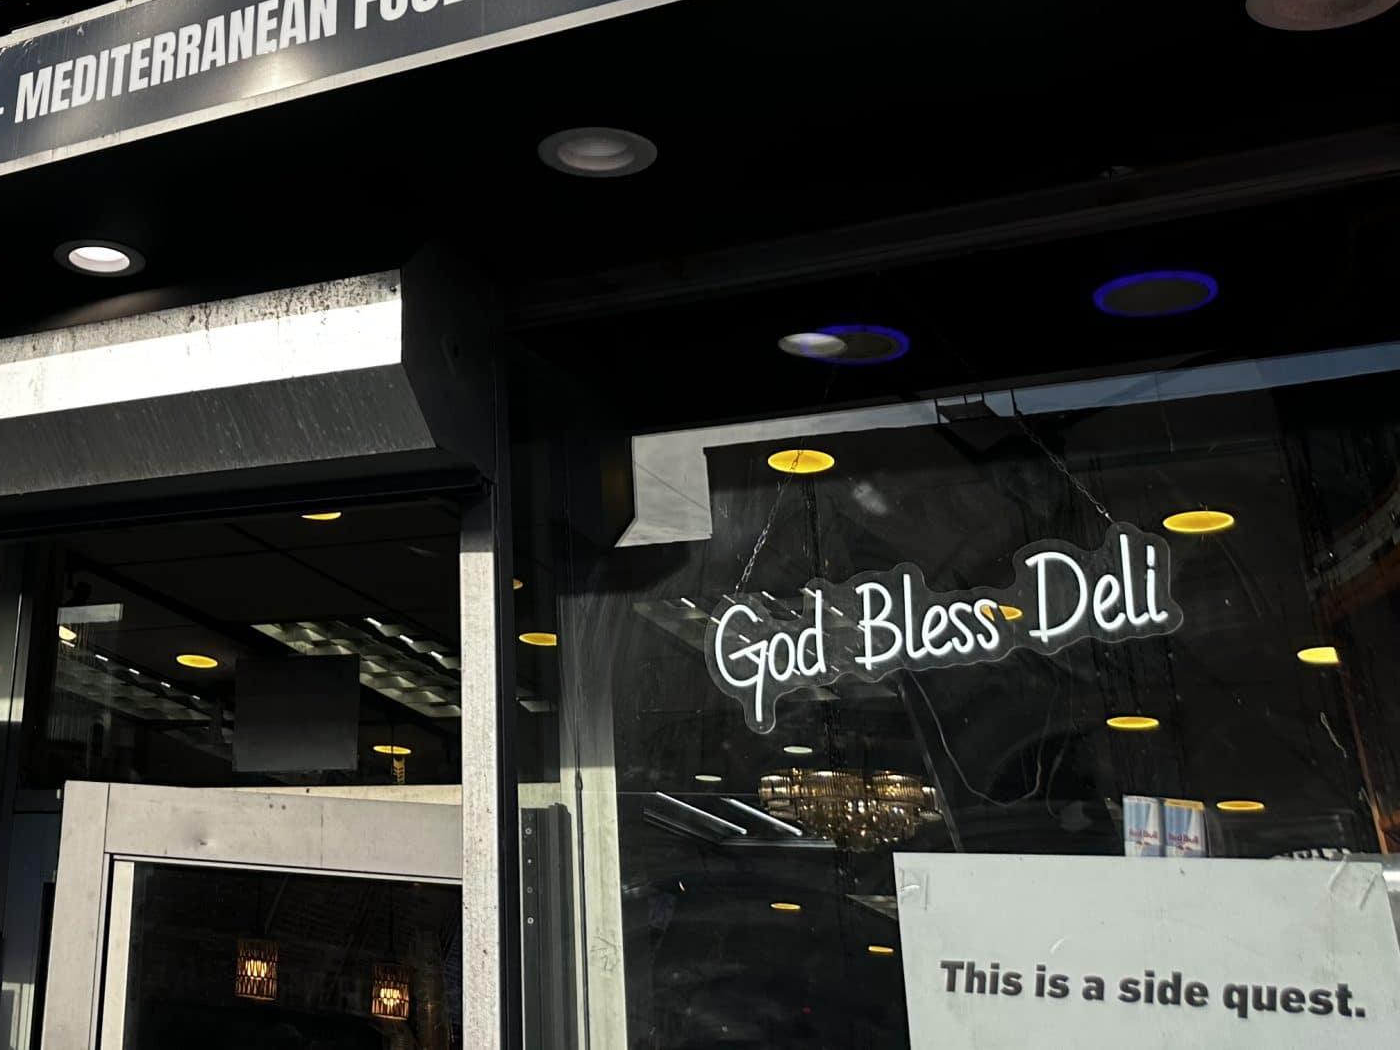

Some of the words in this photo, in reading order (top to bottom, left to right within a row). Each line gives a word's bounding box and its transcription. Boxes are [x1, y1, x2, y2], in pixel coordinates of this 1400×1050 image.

[714, 588, 827, 722] God
[855, 573, 1001, 670] Bless
[1025, 534, 1169, 642] Deli
[940, 960, 1023, 999] This
[1034, 963, 1070, 999] is
[1081, 976, 1106, 1002] a
[1117, 970, 1209, 1008] side
[1222, 982, 1367, 1020] quest.
